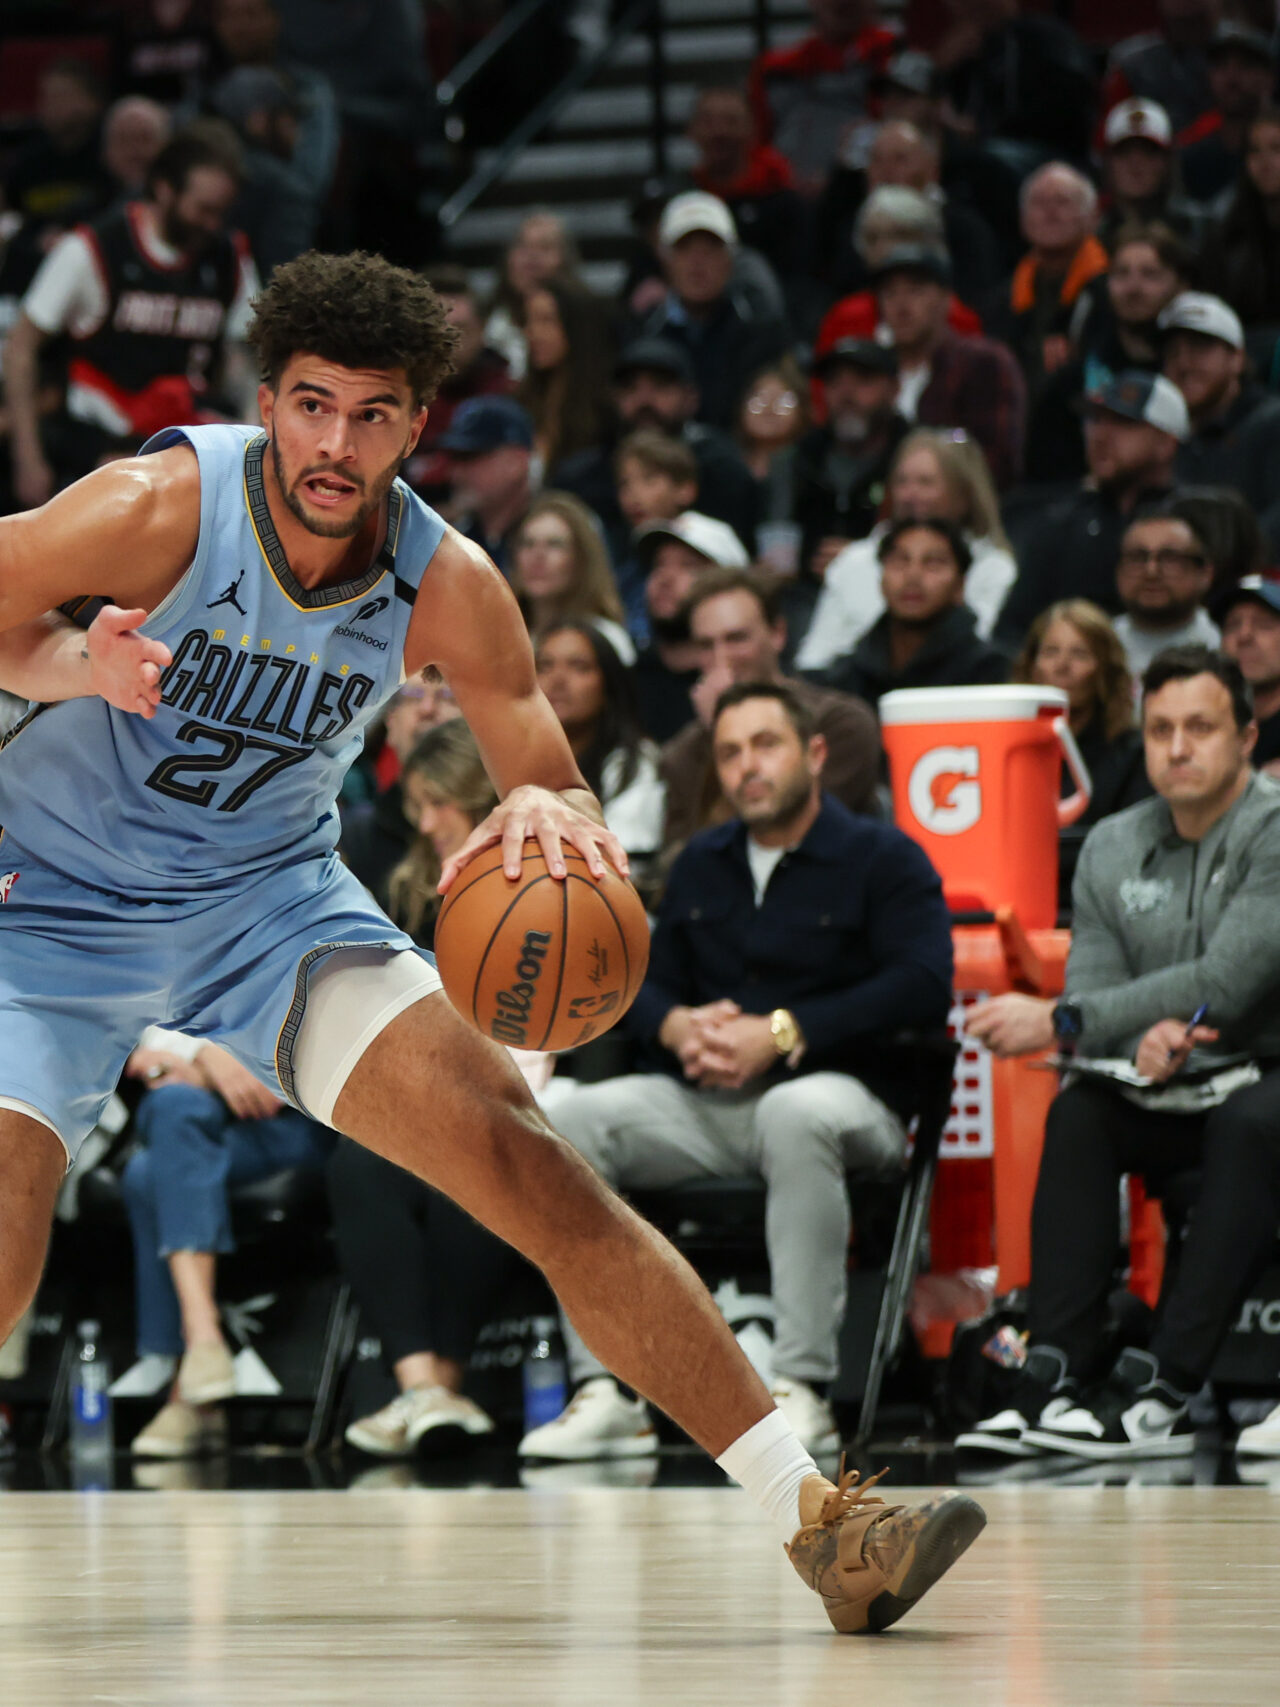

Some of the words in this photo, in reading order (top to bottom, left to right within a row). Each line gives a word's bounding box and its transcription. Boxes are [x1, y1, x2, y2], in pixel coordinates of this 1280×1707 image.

[213, 628, 351, 676] MEMPHS
[334, 625, 389, 652] Robinhood
[159, 628, 376, 744] GRIZZLES
[143, 719, 317, 813] 27
[908, 745, 982, 836] G
[491, 929, 552, 1046] Wilson
